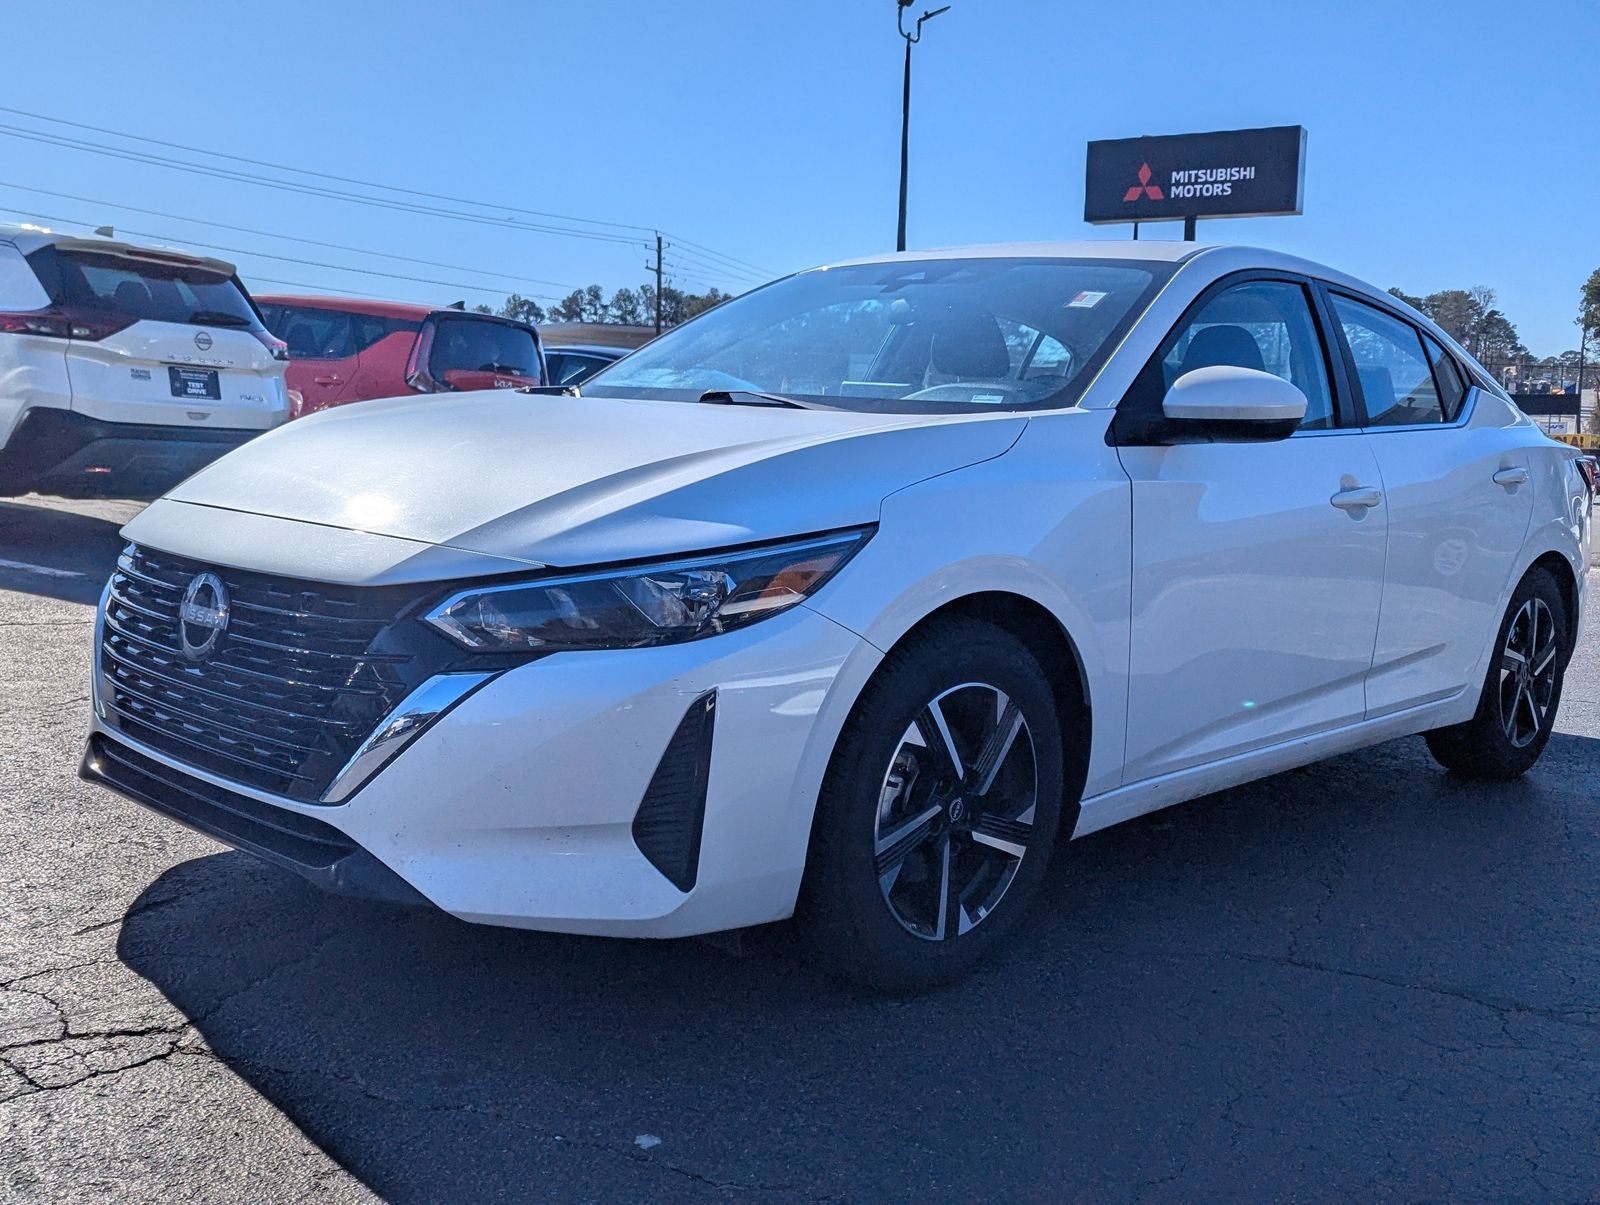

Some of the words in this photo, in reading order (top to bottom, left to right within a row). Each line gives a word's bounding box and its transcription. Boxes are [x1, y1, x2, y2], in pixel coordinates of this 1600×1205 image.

[1171, 166, 1255, 184] MITSUBISHI
[1170, 182, 1232, 198] MOTORS
[187, 381, 204, 389] TEST
